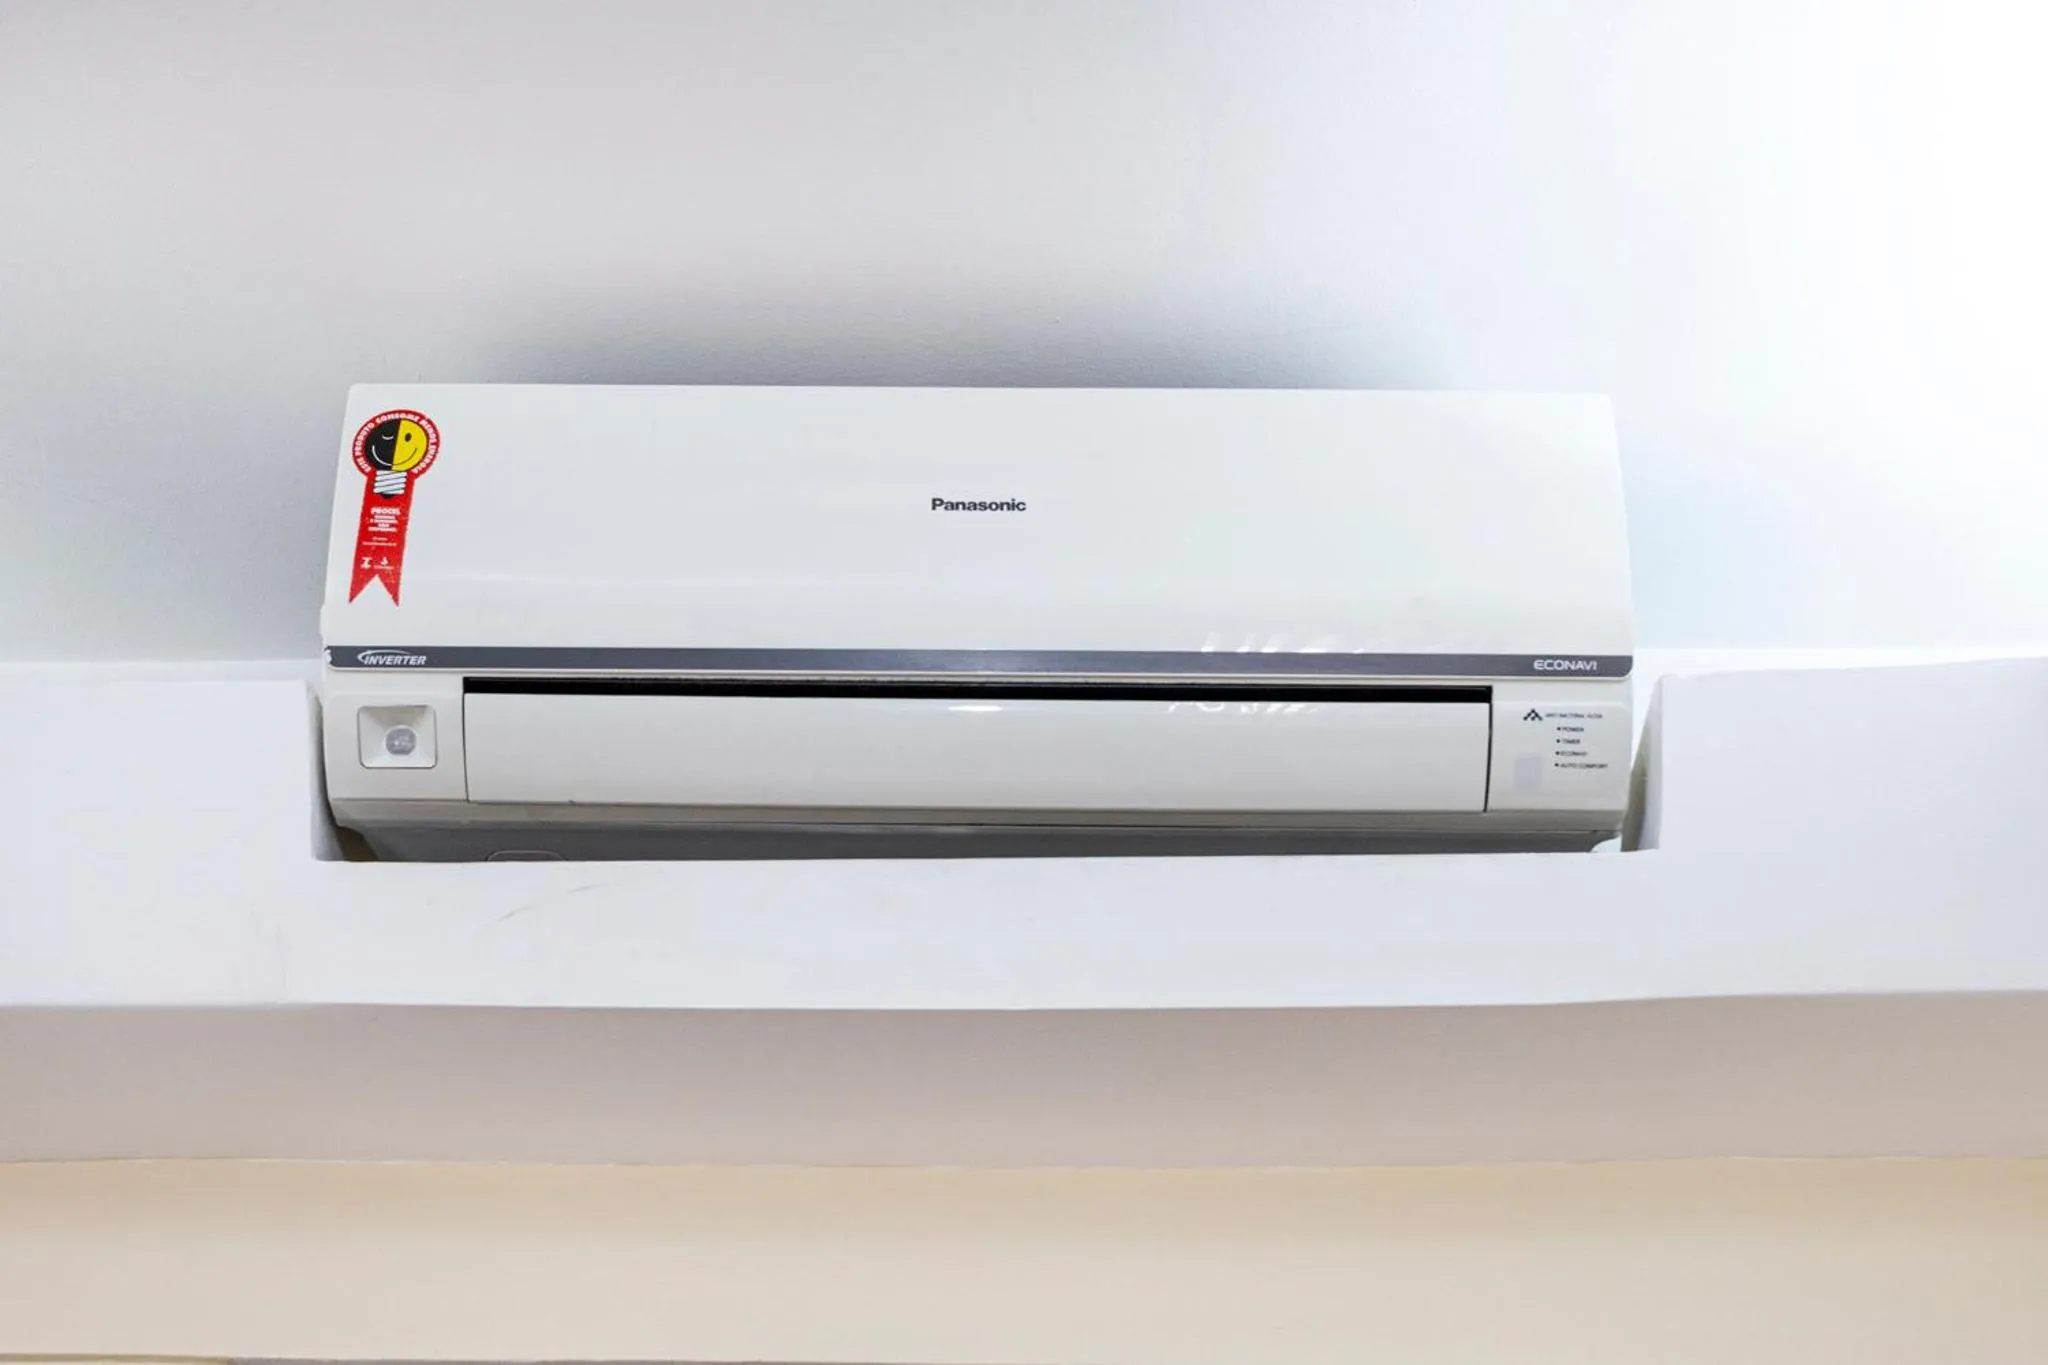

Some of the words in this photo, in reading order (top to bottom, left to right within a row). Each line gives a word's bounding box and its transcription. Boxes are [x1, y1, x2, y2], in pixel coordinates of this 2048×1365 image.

[355, 422, 375, 457] PRODUTO
[376, 412, 420, 424] CONSOME
[419, 419, 438, 442] MENOS
[931, 497, 1027, 511] Panasonic
[363, 655, 427, 666] INVERTER
[1533, 659, 1598, 670] ECONAVI
